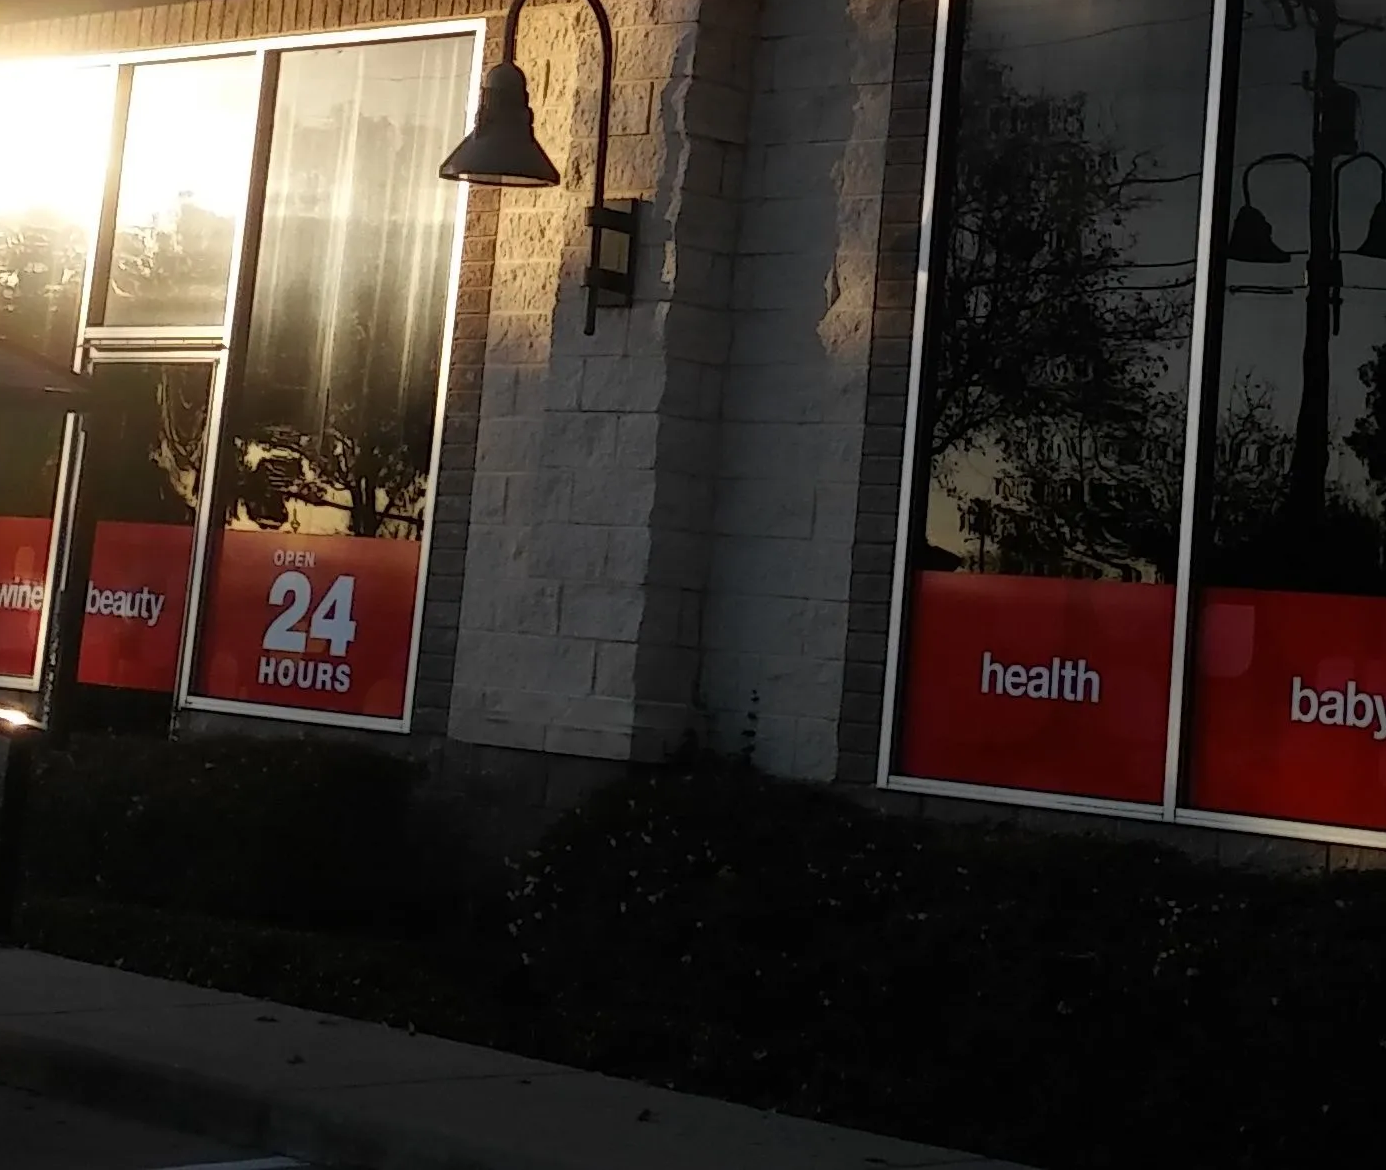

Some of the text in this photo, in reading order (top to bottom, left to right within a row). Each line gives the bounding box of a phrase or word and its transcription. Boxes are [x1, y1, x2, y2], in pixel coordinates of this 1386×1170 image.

[273, 548, 316, 568] OPEN
[84, 580, 165, 628] beauty
[263, 569, 357, 658] 24
[257, 656, 351, 693] HOURS
[980, 651, 1101, 704] health
